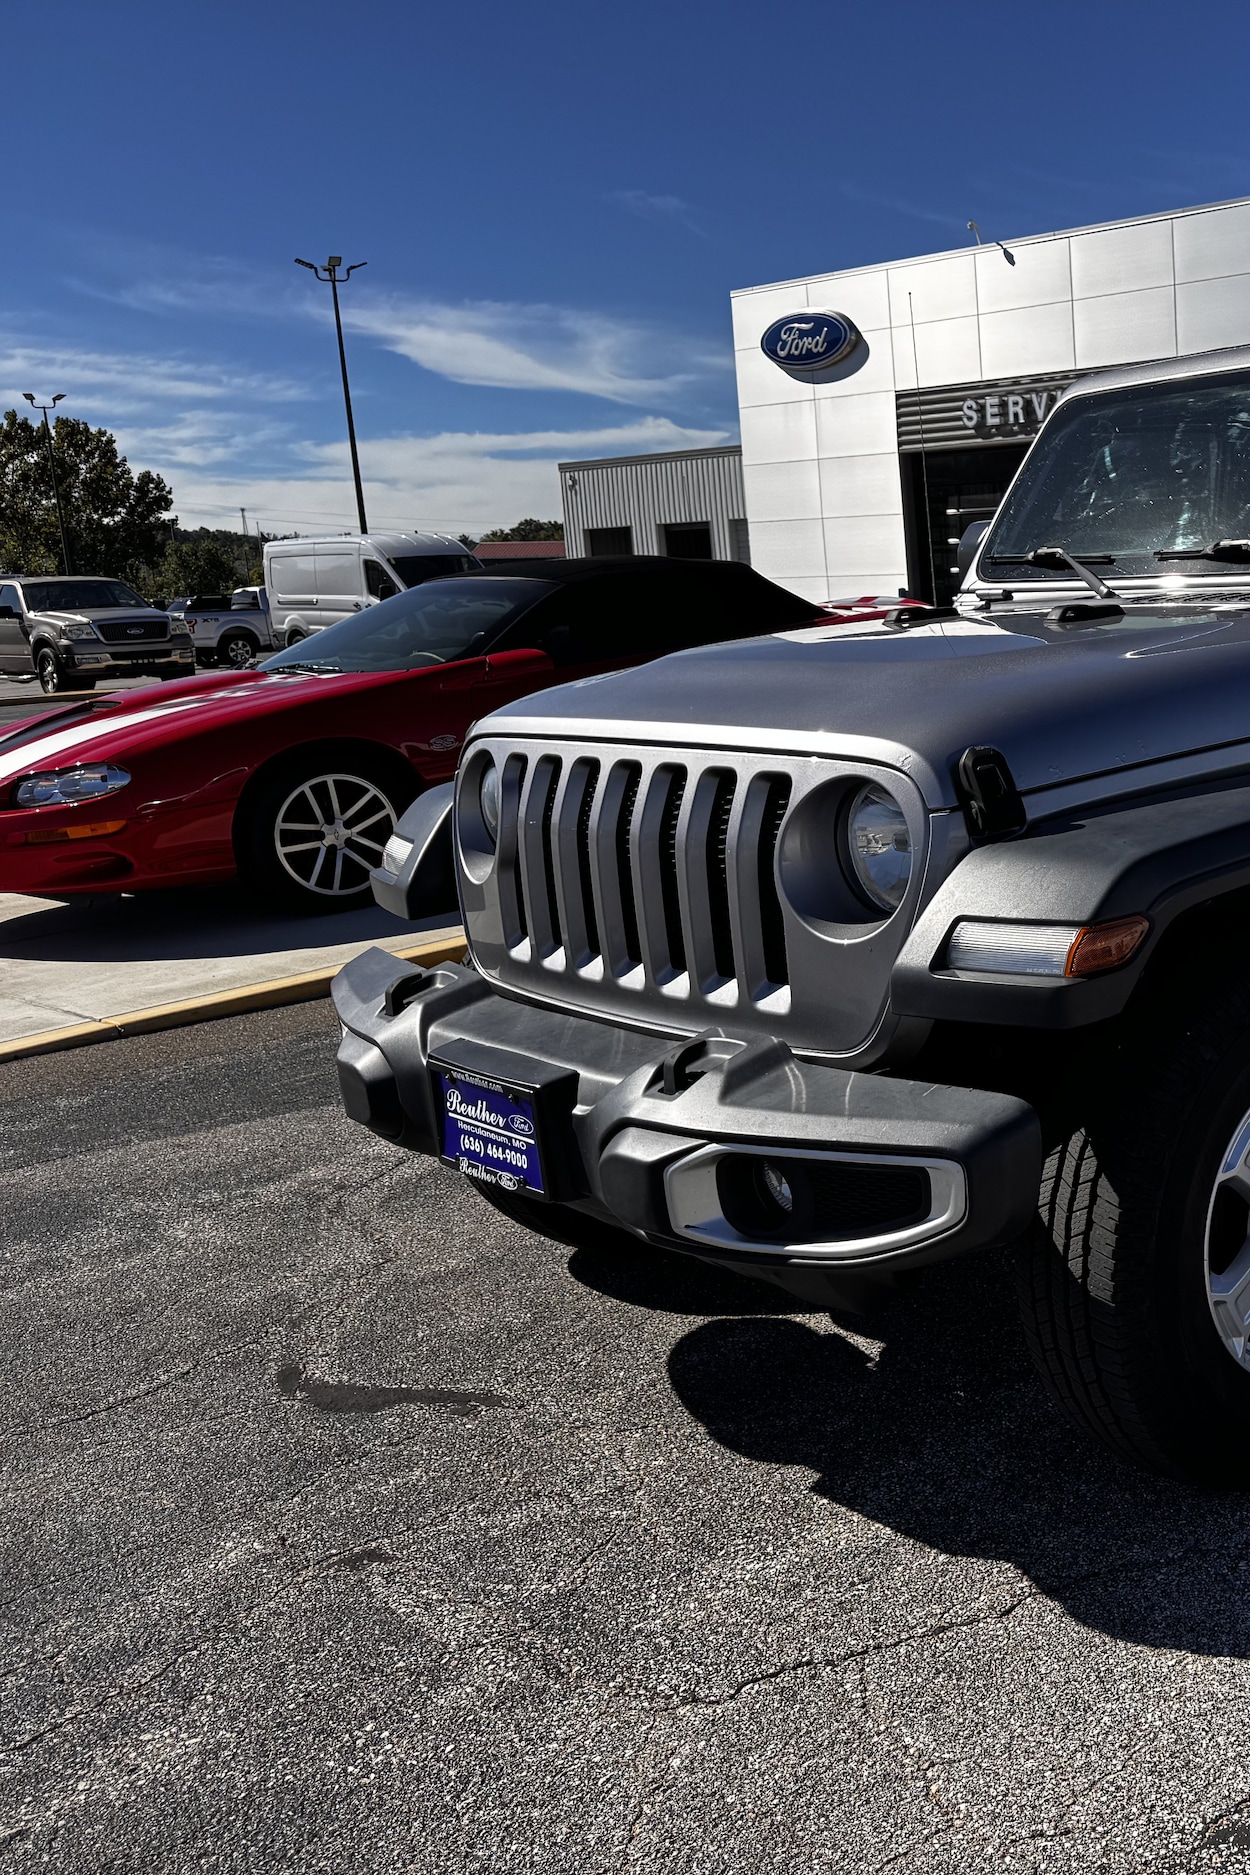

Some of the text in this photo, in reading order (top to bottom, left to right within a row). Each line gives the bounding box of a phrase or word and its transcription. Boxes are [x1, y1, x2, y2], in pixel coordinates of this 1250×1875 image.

[777, 322, 829, 358] Ford
[432, 736, 456, 749] SS
[446, 1088, 507, 1128] Reuther
[457, 1120, 527, 1150] Herculaneum, MO
[460, 1134, 528, 1169] (636) 464-9000
[459, 1156, 498, 1184] Reuther
